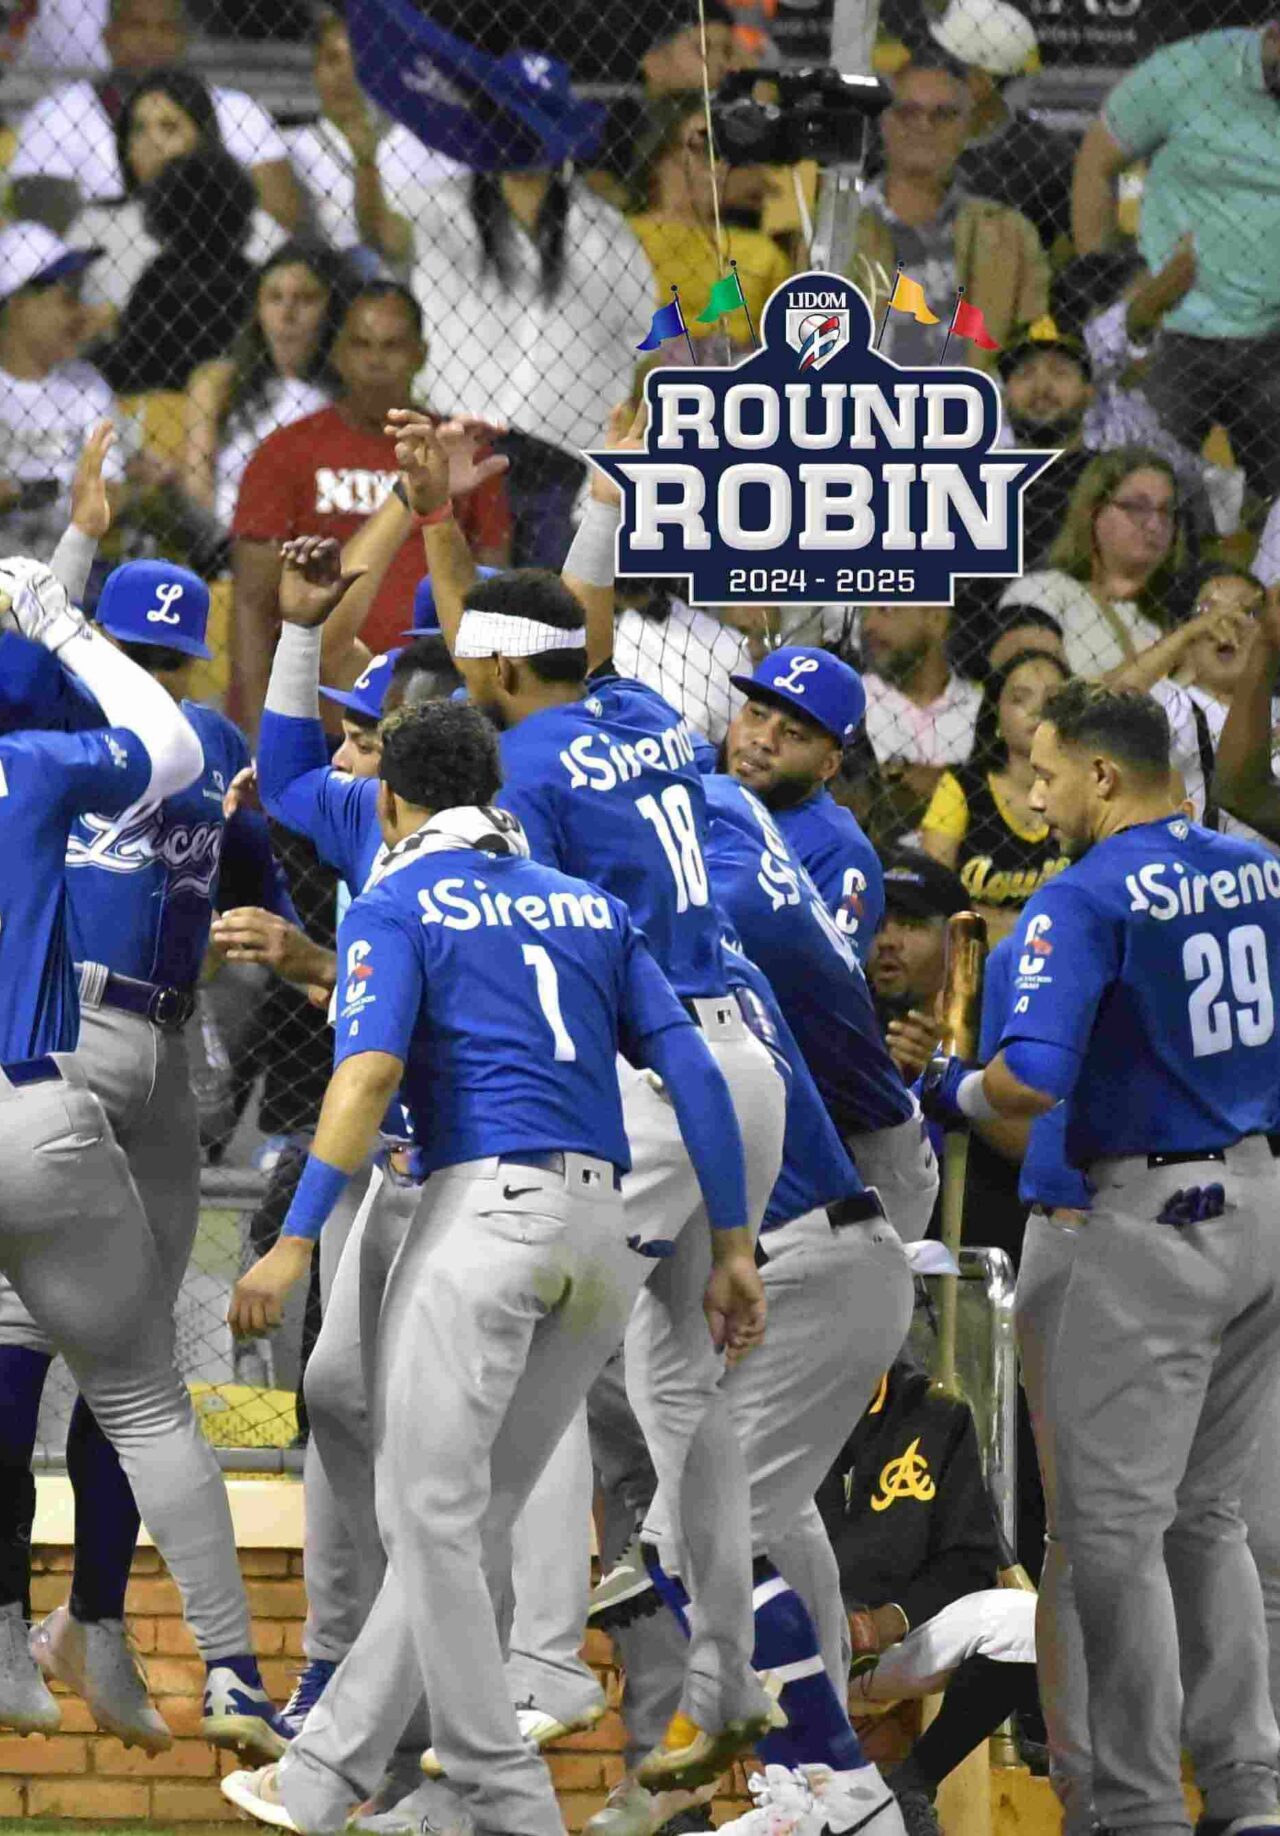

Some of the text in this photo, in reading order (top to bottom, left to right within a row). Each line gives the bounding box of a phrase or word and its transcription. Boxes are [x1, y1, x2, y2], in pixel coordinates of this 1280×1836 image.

[146, 583, 184, 625] L
[773, 656, 819, 694] L
[635, 783, 709, 914] 18
[417, 878, 615, 931] Sirena
[521, 943, 577, 1062] 1
[1182, 924, 1275, 1058] 29
